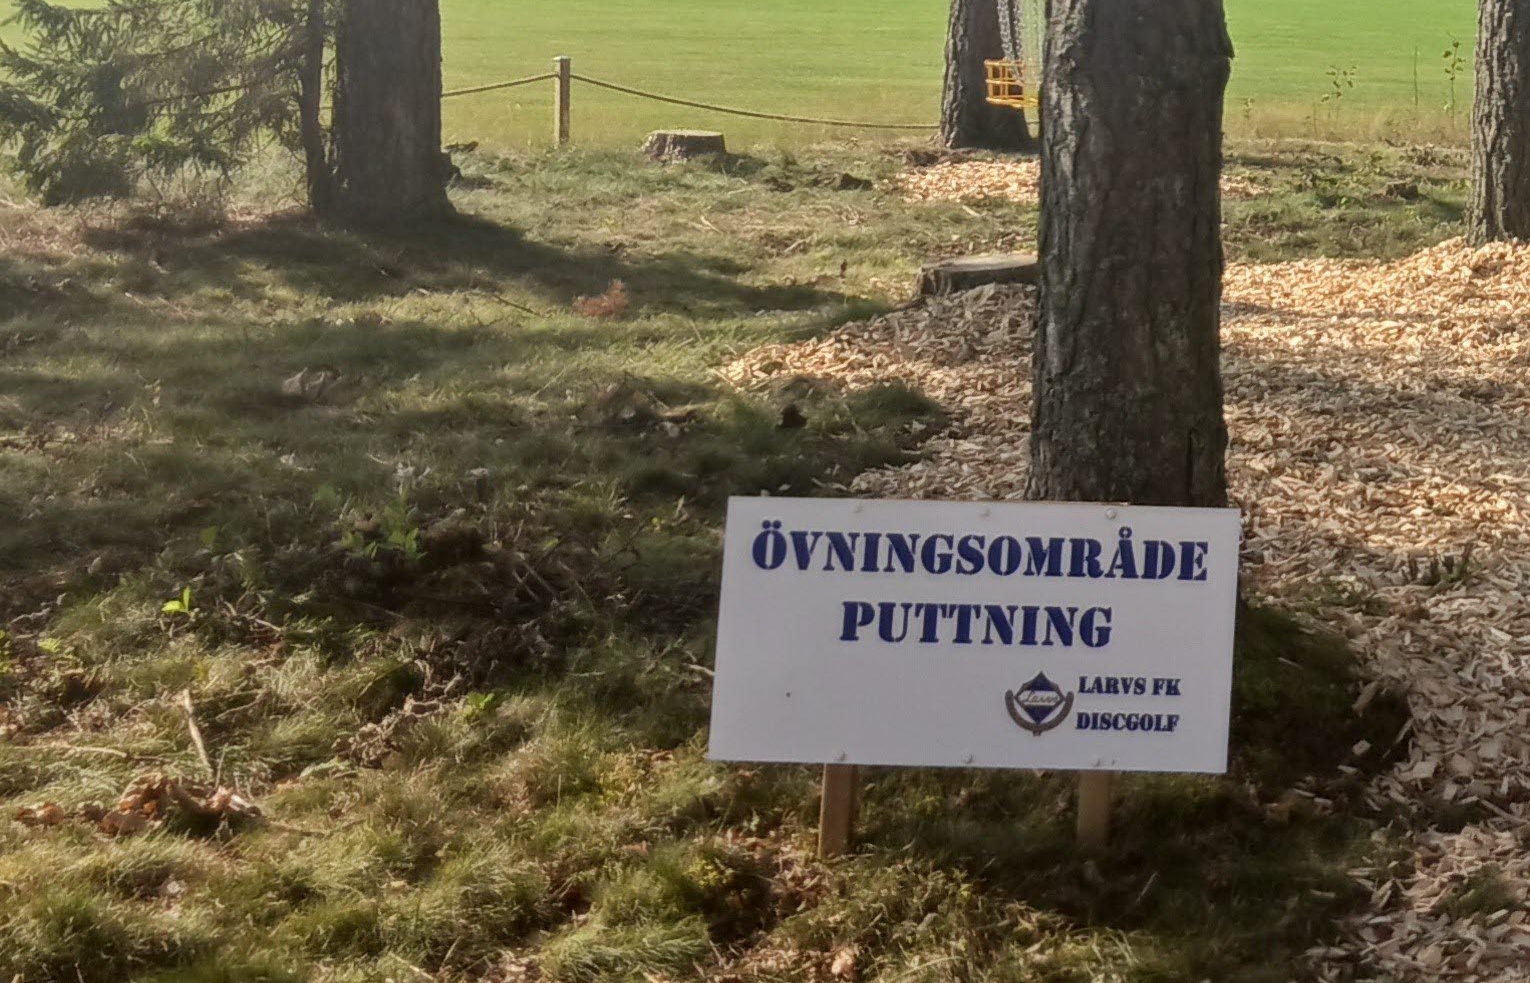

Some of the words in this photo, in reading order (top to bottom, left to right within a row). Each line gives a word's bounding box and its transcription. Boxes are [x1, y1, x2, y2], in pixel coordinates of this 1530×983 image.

[751, 520, 1209, 581] ÖVNINGSOMRÅDE
[839, 601, 1113, 648] PUTTNING
[1078, 676, 1147, 695] LARVS
[1151, 677, 1181, 696] FK
[1076, 712, 1180, 732] DISCGOLF
